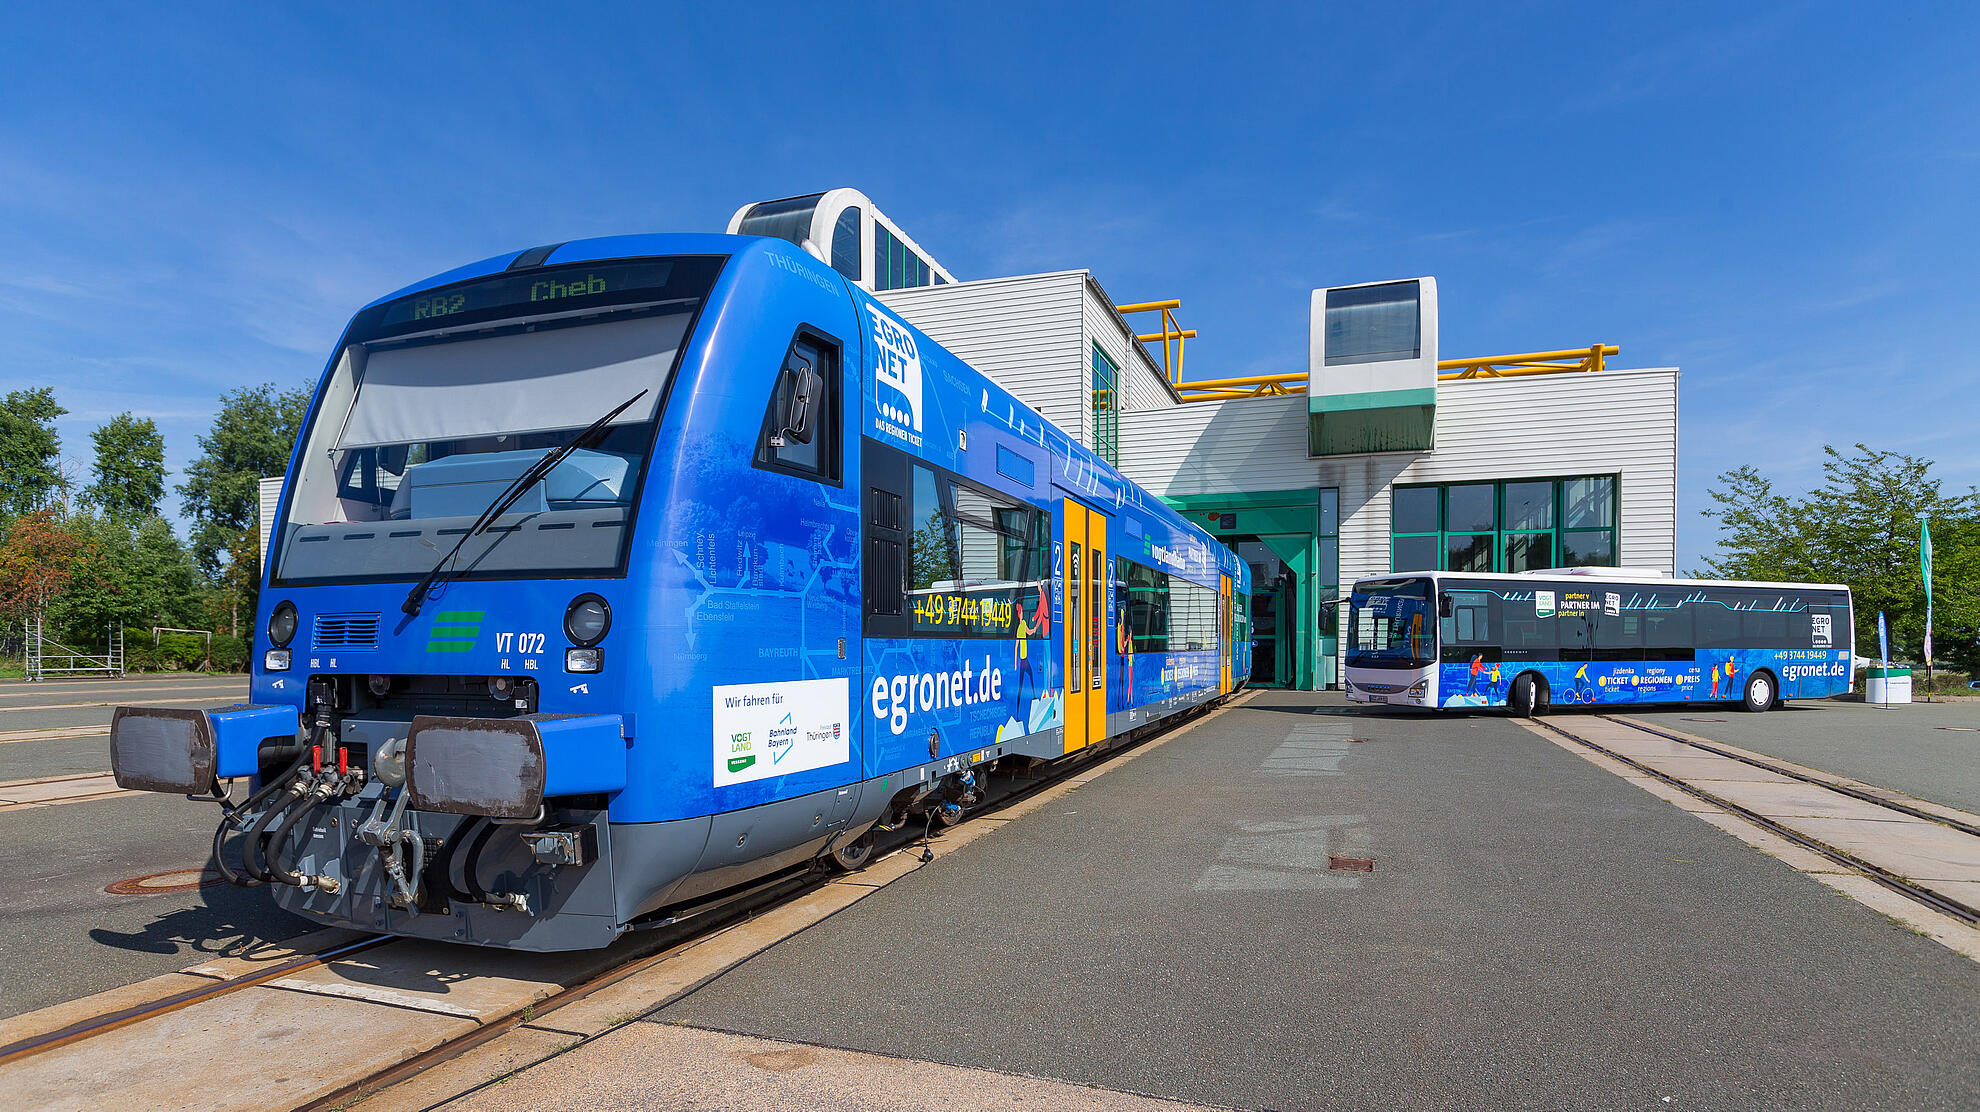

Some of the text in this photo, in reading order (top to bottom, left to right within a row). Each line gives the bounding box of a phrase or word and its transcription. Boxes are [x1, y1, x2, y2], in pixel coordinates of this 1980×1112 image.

[763, 251, 840, 297] THÜRINGEN
[414, 275, 606, 320] RB2 Cheb
[876, 341, 908, 384] NET
[876, 417, 923, 448] DAS REGIONEN TICKET
[696, 530, 705, 568] Schney
[708, 533, 717, 584] Lichtenfels
[1054, 545, 1061, 576] 2
[1108, 562, 1114, 588] 2
[707, 600, 723, 609] Bad
[1560, 601, 1600, 610] PARTNER IM
[914, 594, 1012, 629] +49 3744 19449
[1558, 610, 1577, 618] partner
[1812, 617, 1830, 625] EGRO
[1812, 625, 1825, 633] NET
[496, 633, 545, 654] VT 072
[759, 648, 799, 658] BAYREUTH
[1774, 651, 1827, 660] +49 3744 19449
[310, 658, 338, 668] HBL HL
[501, 659, 539, 670] HL HBL
[1646, 667, 1665, 676] regiony
[1782, 661, 1845, 682] egronet.de
[1606, 676, 1628, 685] TICKET
[1640, 676, 1672, 684] REGIONEN
[1683, 675, 1700, 683] PREIS
[872, 654, 1002, 735] egronet.de
[1638, 685, 1656, 693] regions
[725, 693, 783, 708] Wir fahren für
[731, 732, 752, 743] VOGT
[769, 726, 797, 738] Bahnland
[732, 742, 752, 752] LAND
[768, 738, 789, 748] Bayern
